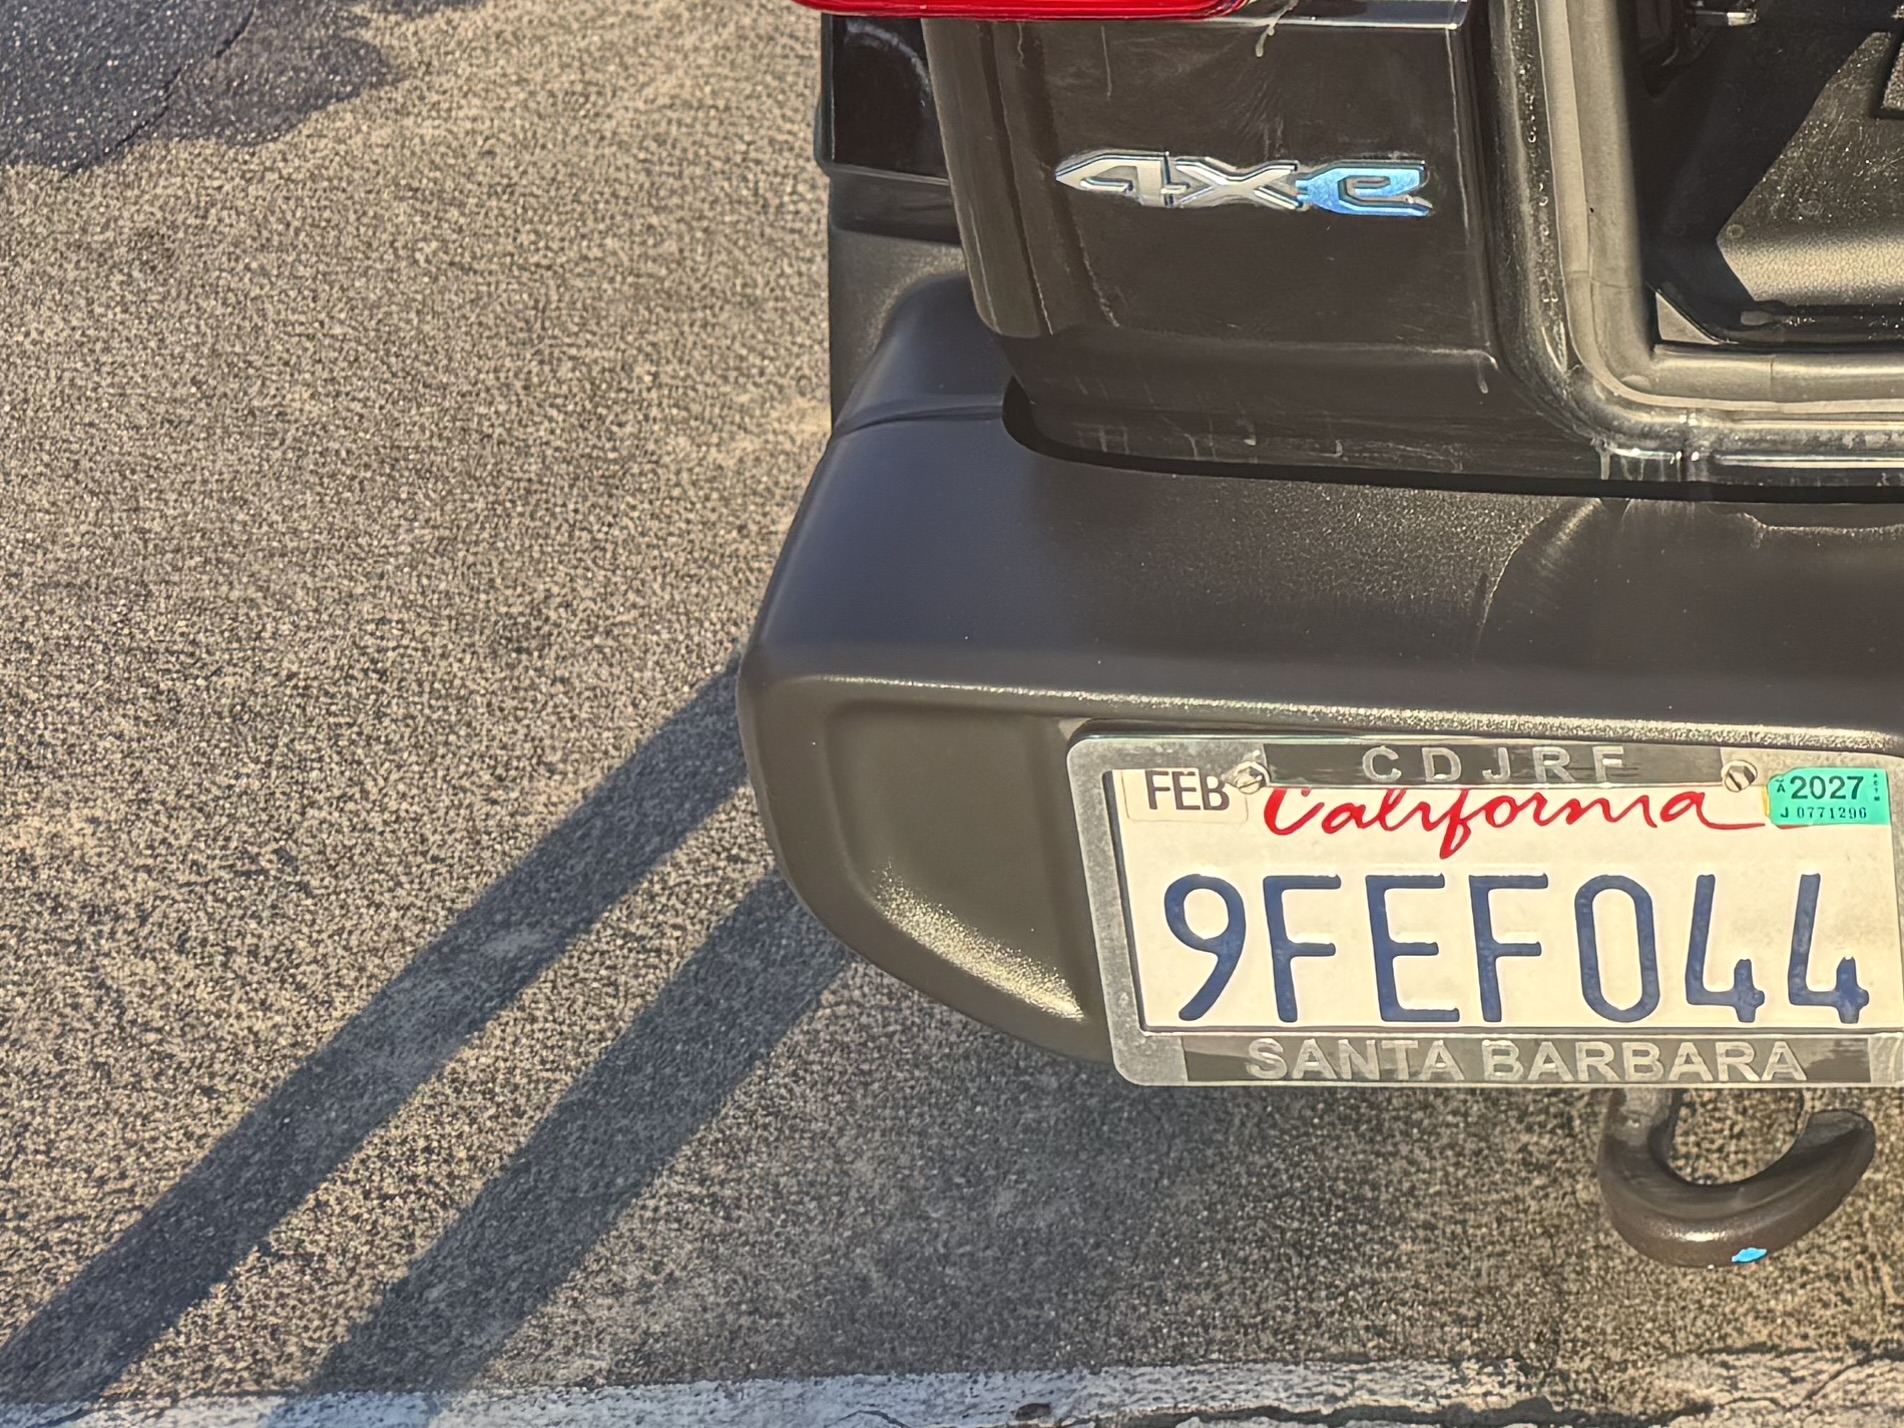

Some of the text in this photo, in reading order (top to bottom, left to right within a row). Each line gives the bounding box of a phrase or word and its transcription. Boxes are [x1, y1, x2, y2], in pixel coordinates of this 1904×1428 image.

[1145, 769, 1231, 812] FEB
[1790, 775, 1864, 800] 2027
[1264, 788, 1766, 860] California
[1164, 873, 1870, 1024] 9FEF044
[1246, 1038, 1808, 1082] SANTA BARBARA
